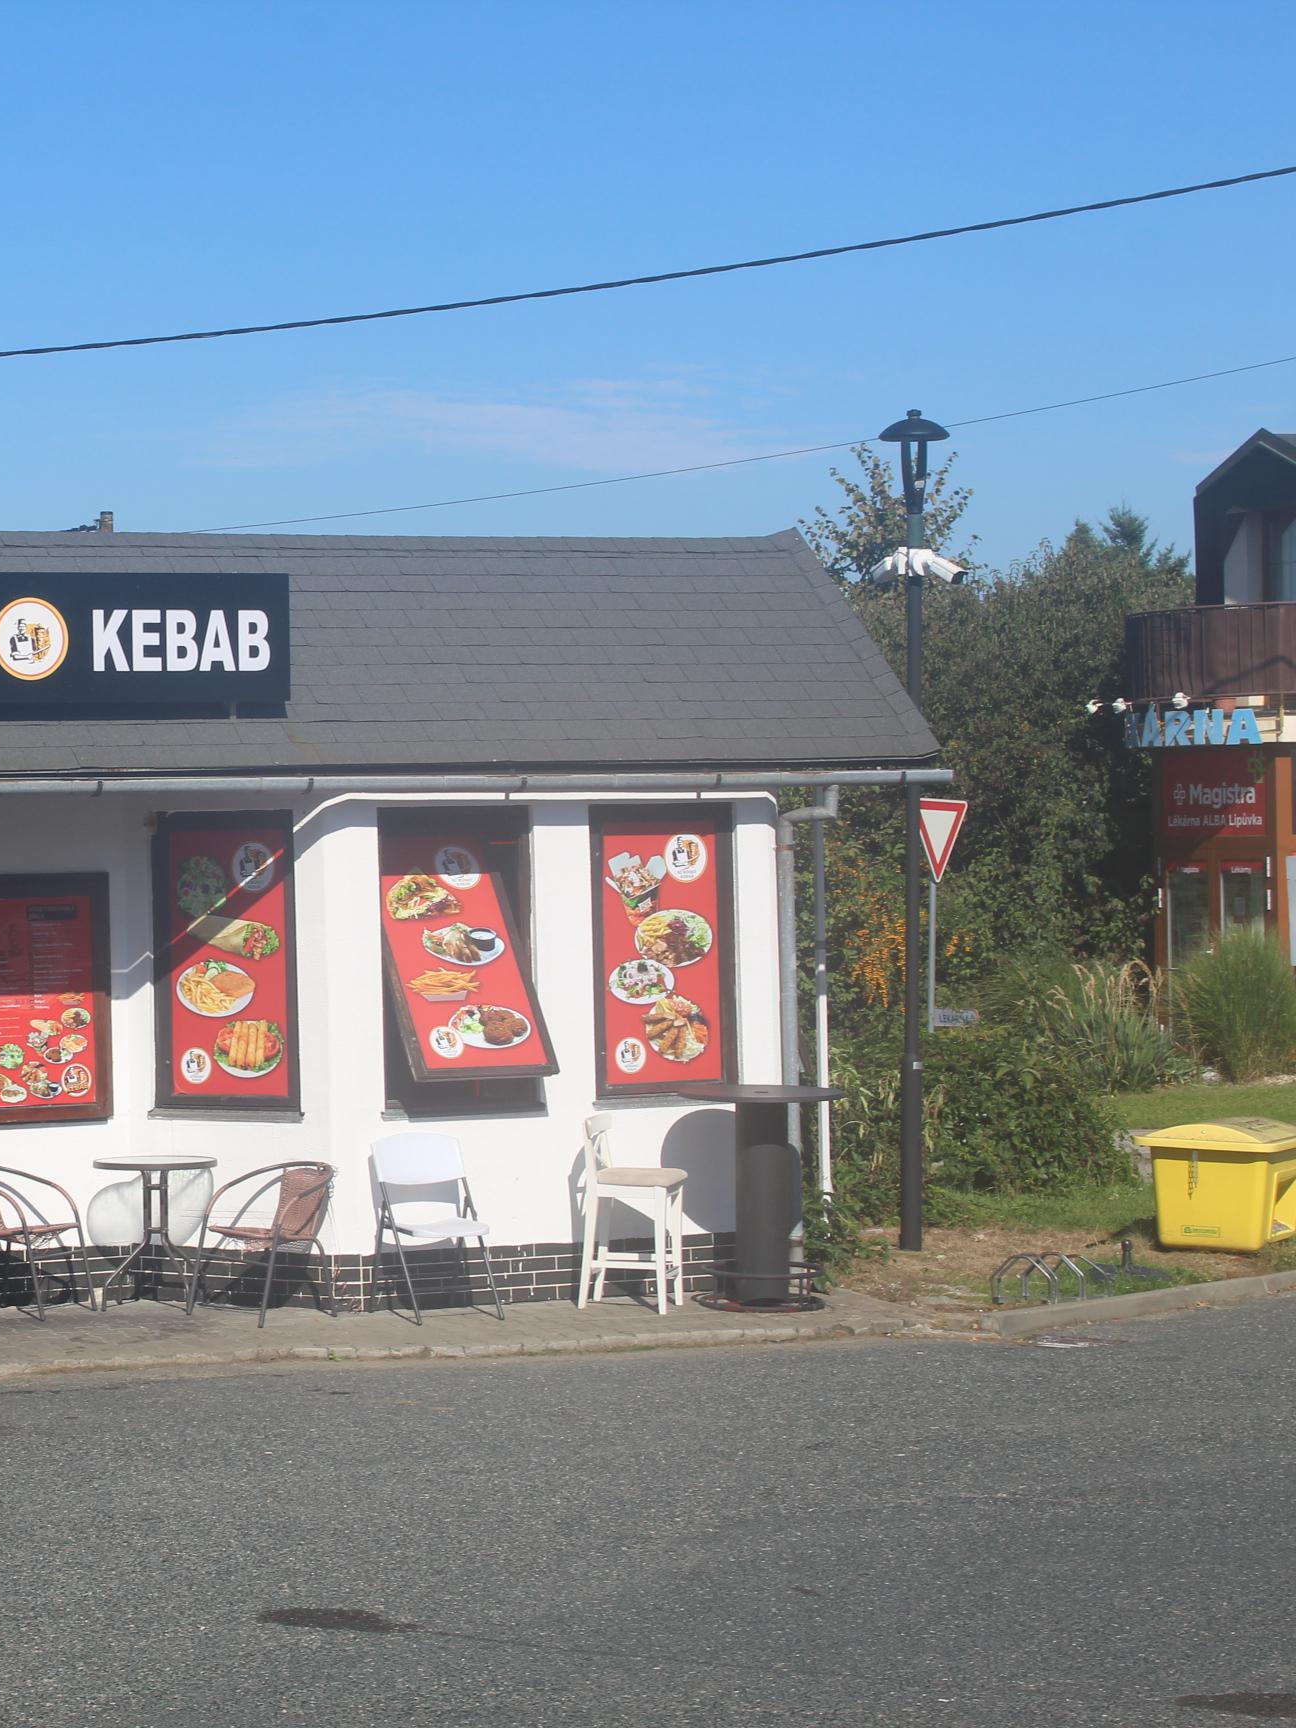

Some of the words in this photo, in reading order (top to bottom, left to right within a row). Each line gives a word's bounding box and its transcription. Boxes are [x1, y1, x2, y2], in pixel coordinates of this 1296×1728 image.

[92, 608, 271, 673] KEBAB
[1189, 782, 1256, 808] Magistra
[1203, 814, 1225, 826] ALBA
[1228, 811, 1263, 828] Lipůvka
